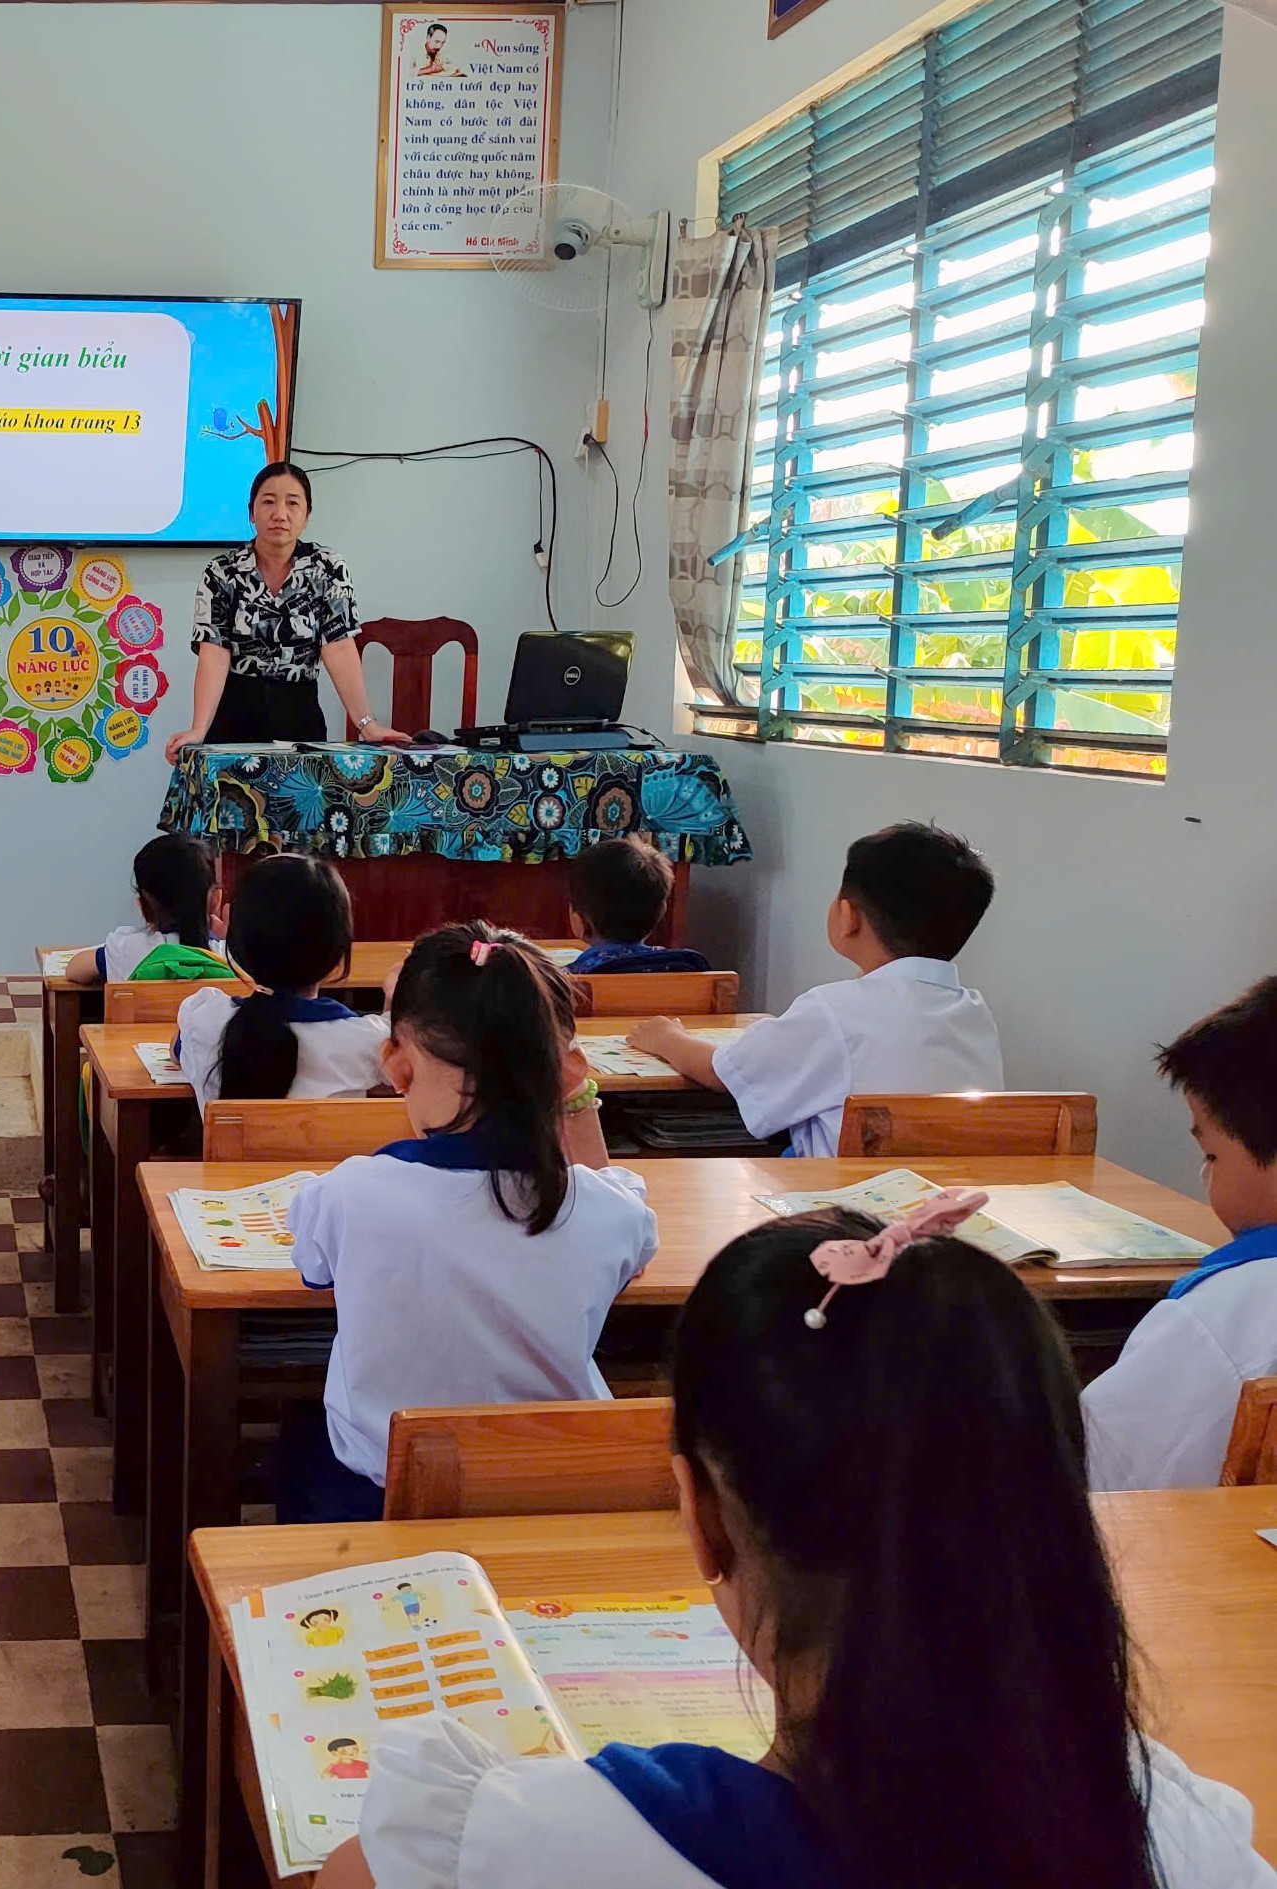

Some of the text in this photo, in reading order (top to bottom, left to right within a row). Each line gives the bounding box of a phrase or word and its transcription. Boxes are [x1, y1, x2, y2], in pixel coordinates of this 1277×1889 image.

[513, 43, 539, 56] sông
[469, 62, 539, 76] Việt Nam có
[406, 79, 539, 94] trở nên tươi đẹp hay
[405, 98, 537, 111] không, dân tộc Việt
[405, 115, 537, 127] Nam có bước tới đài
[404, 131, 536, 147] vinh quang để sánh vai
[404, 150, 535, 164] với các cường quốc năm
[403, 168, 535, 181] châu được hay không,
[402, 186, 501, 198] chính là nhờ một
[402, 203, 420, 214] lớn
[424, 202, 431, 214] ở
[435, 203, 462, 216] công
[466, 203, 486, 216] học
[401, 221, 420, 231] các
[16, 347, 70, 373] gian
[77, 340, 128, 370] biểu
[23, 413, 65, 430] khoa
[71, 415, 116, 434] trang
[122, 414, 141, 431] 13
[29, 626, 74, 653] 10
[17, 658, 90, 675] NĂNG LỰC
